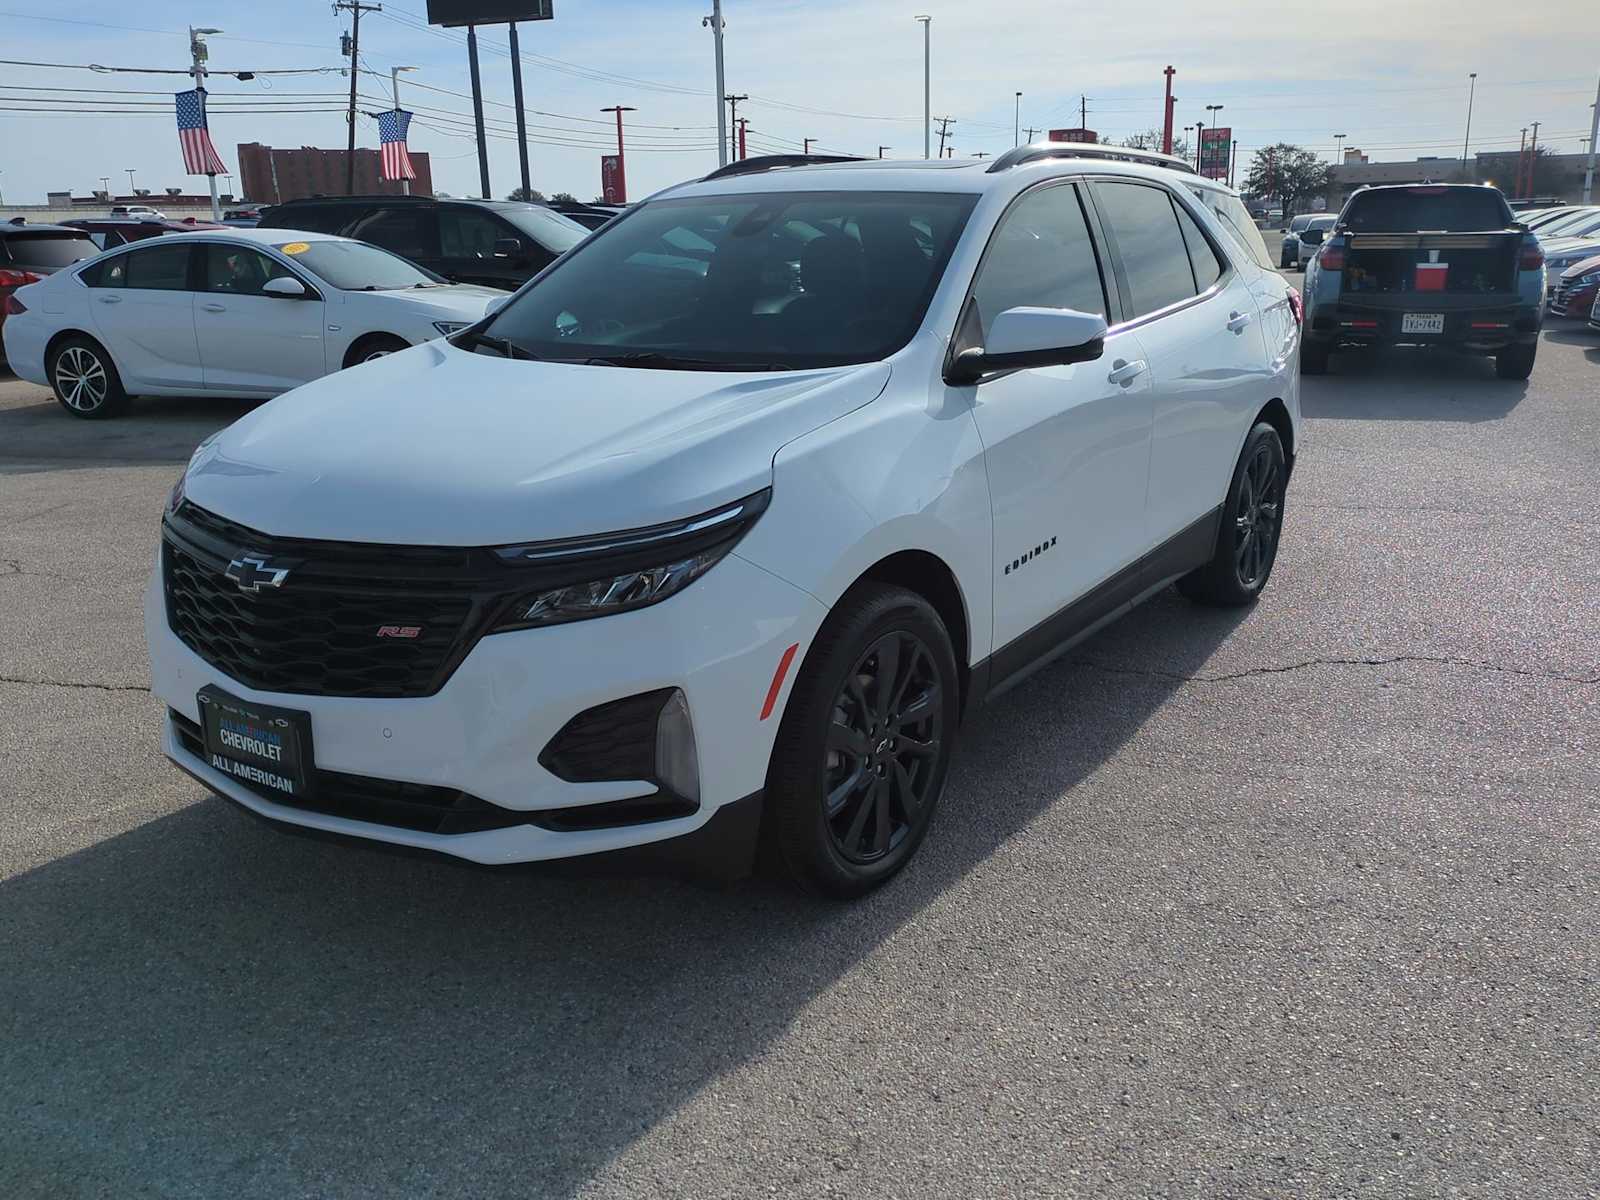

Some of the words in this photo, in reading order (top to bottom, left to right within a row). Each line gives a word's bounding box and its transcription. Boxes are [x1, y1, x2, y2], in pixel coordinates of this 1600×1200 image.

[1004, 535, 1057, 575] EQUINOX
[376, 626, 421, 637] RS
[220, 728, 282, 761] CHEVROLET
[212, 754, 233, 773] ALL
[233, 762, 293, 793] AMERICAN
